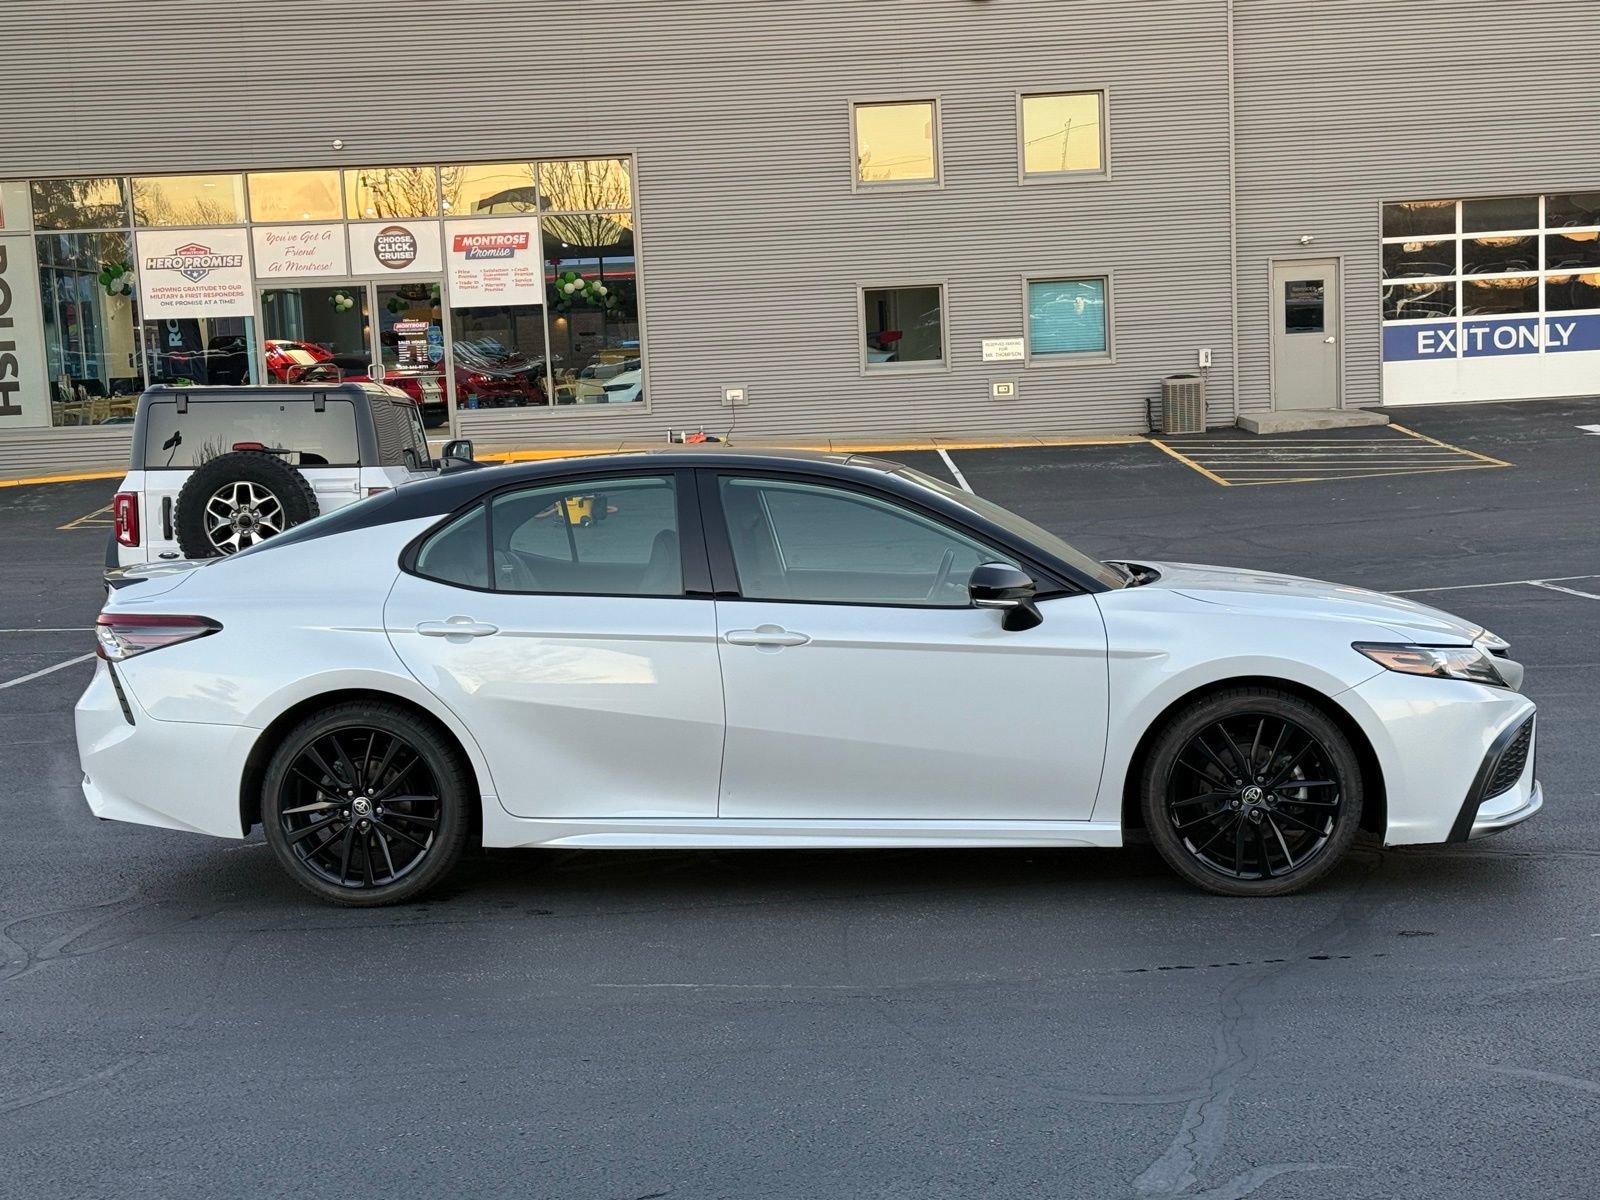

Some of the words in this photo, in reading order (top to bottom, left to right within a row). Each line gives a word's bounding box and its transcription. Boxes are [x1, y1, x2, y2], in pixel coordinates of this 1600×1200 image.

[266, 231, 298, 246] You've
[300, 231, 319, 244] Got
[321, 230, 332, 240] A
[462, 235, 527, 246] MONTROSE
[284, 246, 317, 257] Friend
[378, 243, 414, 252] CLICK.
[469, 246, 511, 258] Promise
[146, 257, 183, 270] HERO
[184, 255, 243, 269] PROMISE
[268, 262, 283, 272] At
[285, 262, 333, 272] Montrose!
[1417, 328, 1490, 354] EXIT
[1493, 322, 1577, 350] ONLY
